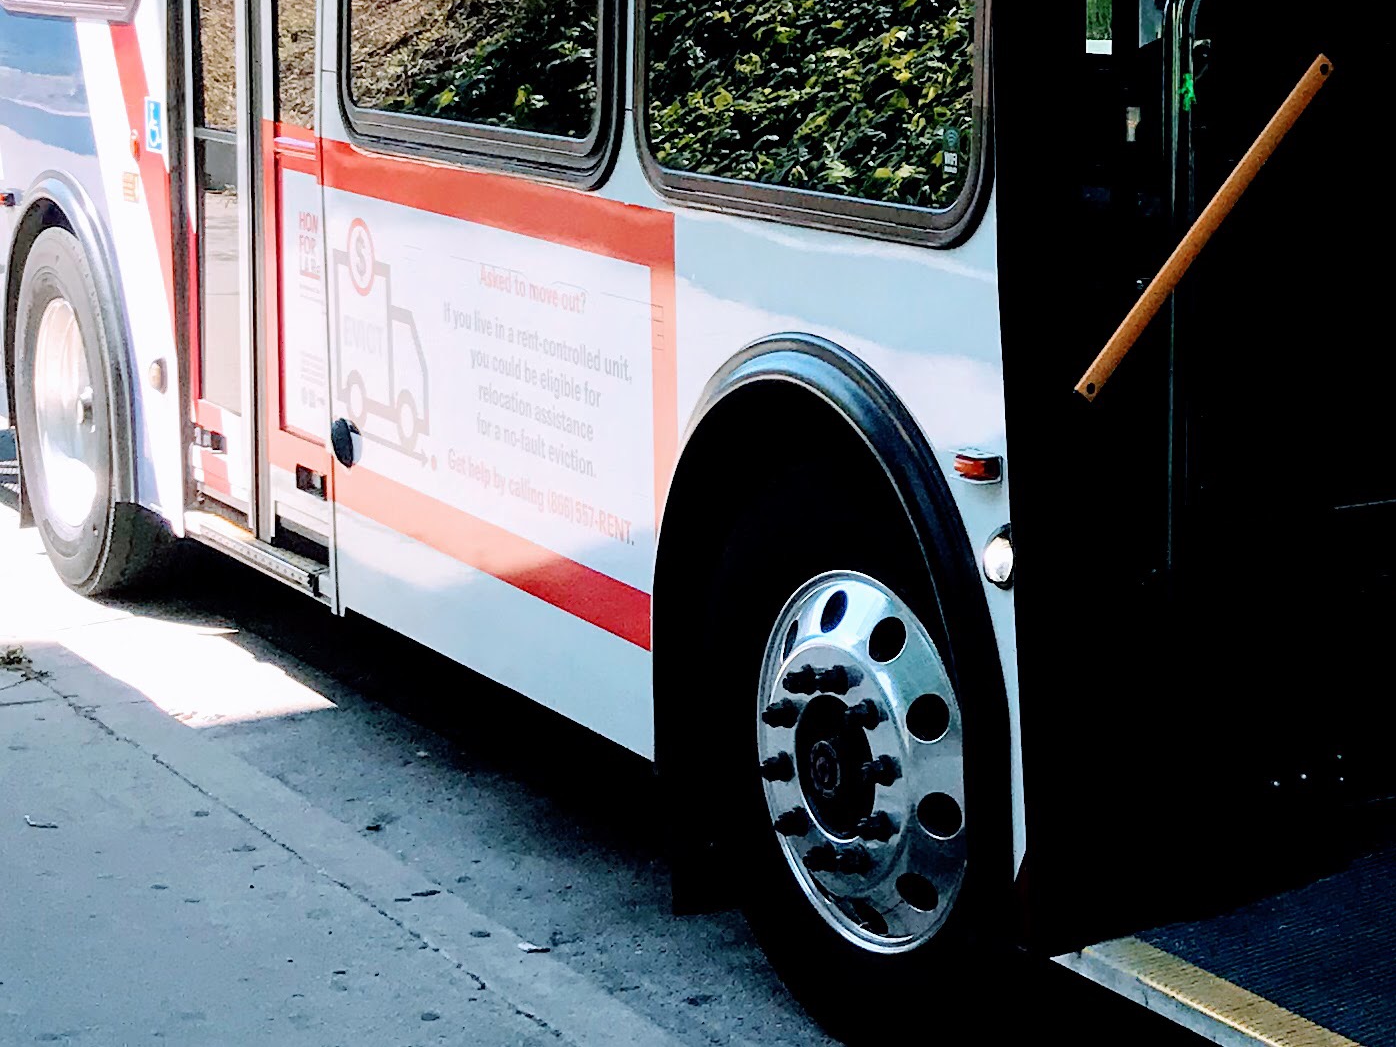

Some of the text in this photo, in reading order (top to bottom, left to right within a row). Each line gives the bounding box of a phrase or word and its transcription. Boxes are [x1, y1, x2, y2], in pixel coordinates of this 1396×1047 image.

[479, 264, 587, 314] Asked to move out?
[452, 306, 472, 330] you
[474, 309, 493, 337] live
[495, 316, 505, 340] in
[507, 326, 514, 343] a
[516, 329, 601, 373] rent-controlled
[604, 355, 633, 385] unit,
[469, 347, 602, 408] you could be eligible for
[478, 382, 594, 442] relocation assistance
[476, 412, 597, 478] for a no-fault eviction.
[448, 448, 467, 476] Get
[468, 455, 491, 489] help
[493, 465, 506, 496] by
[508, 476, 545, 513] calling
